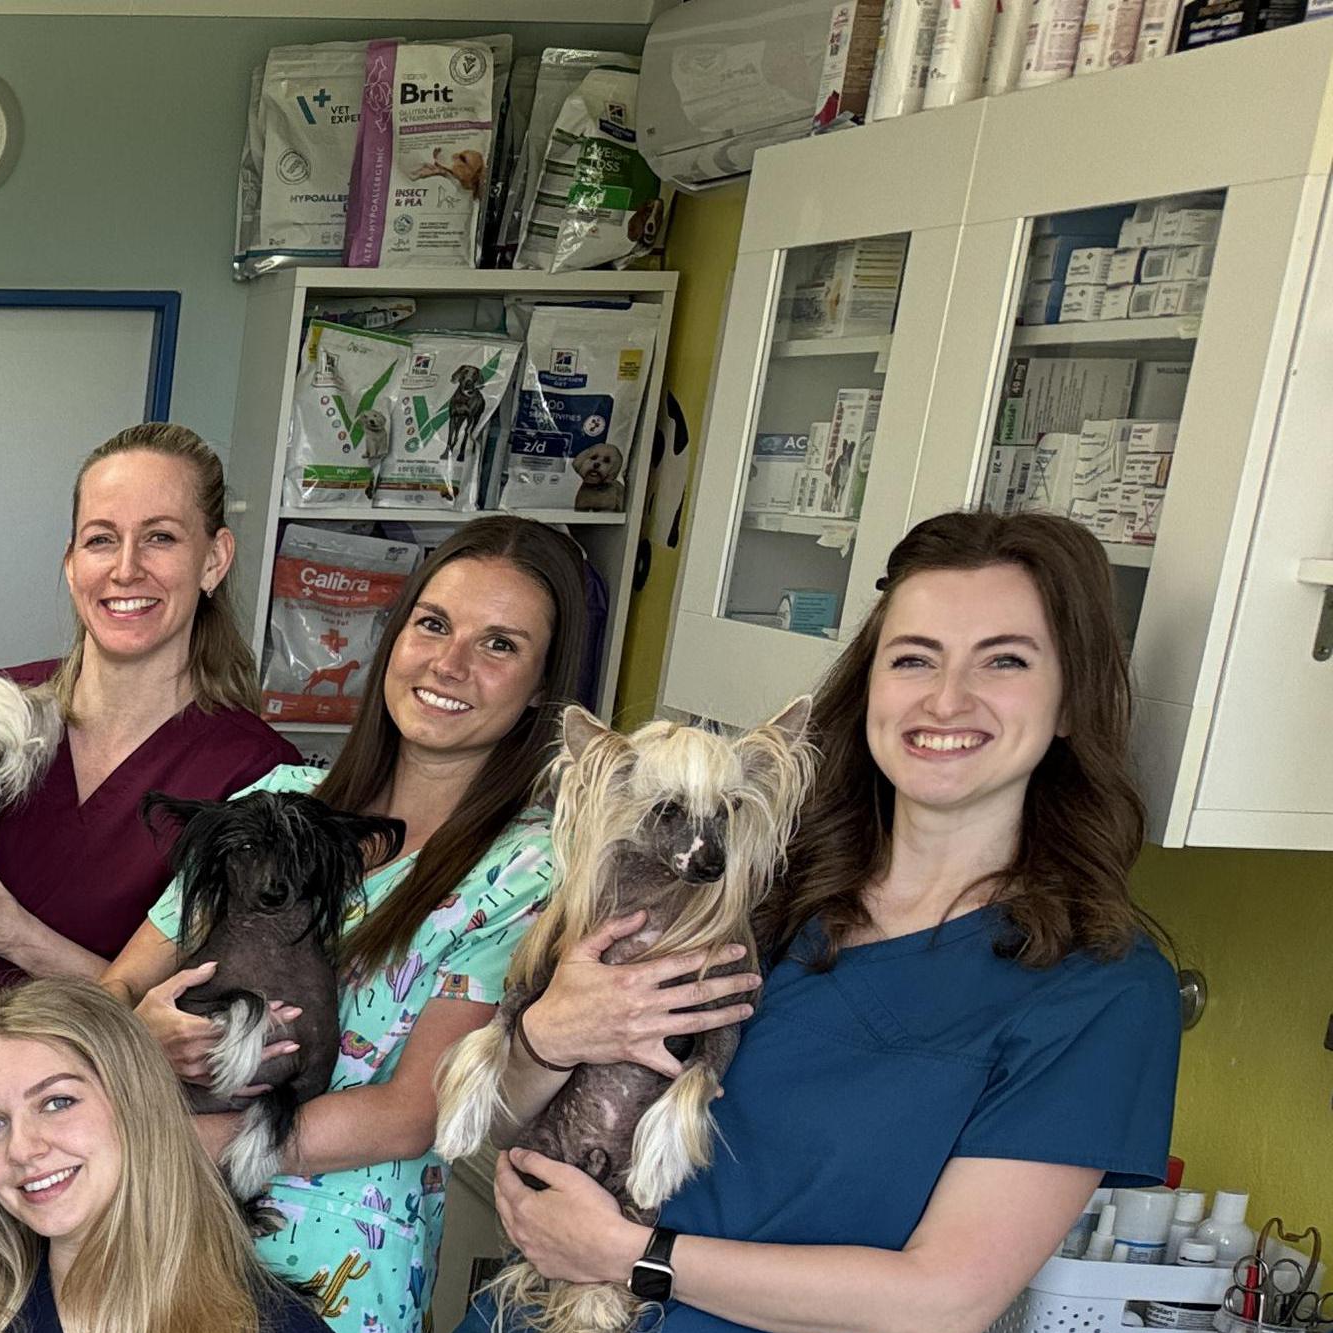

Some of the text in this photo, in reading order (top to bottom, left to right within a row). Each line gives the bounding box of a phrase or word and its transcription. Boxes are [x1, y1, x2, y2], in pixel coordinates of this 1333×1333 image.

[400, 83, 453, 104] Brit
[331, 106, 350, 115] VET
[395, 188, 428, 197] INSECT
[405, 199, 422, 207] PEA
[523, 440, 547, 454] z/d
[301, 567, 371, 592] Calibra
